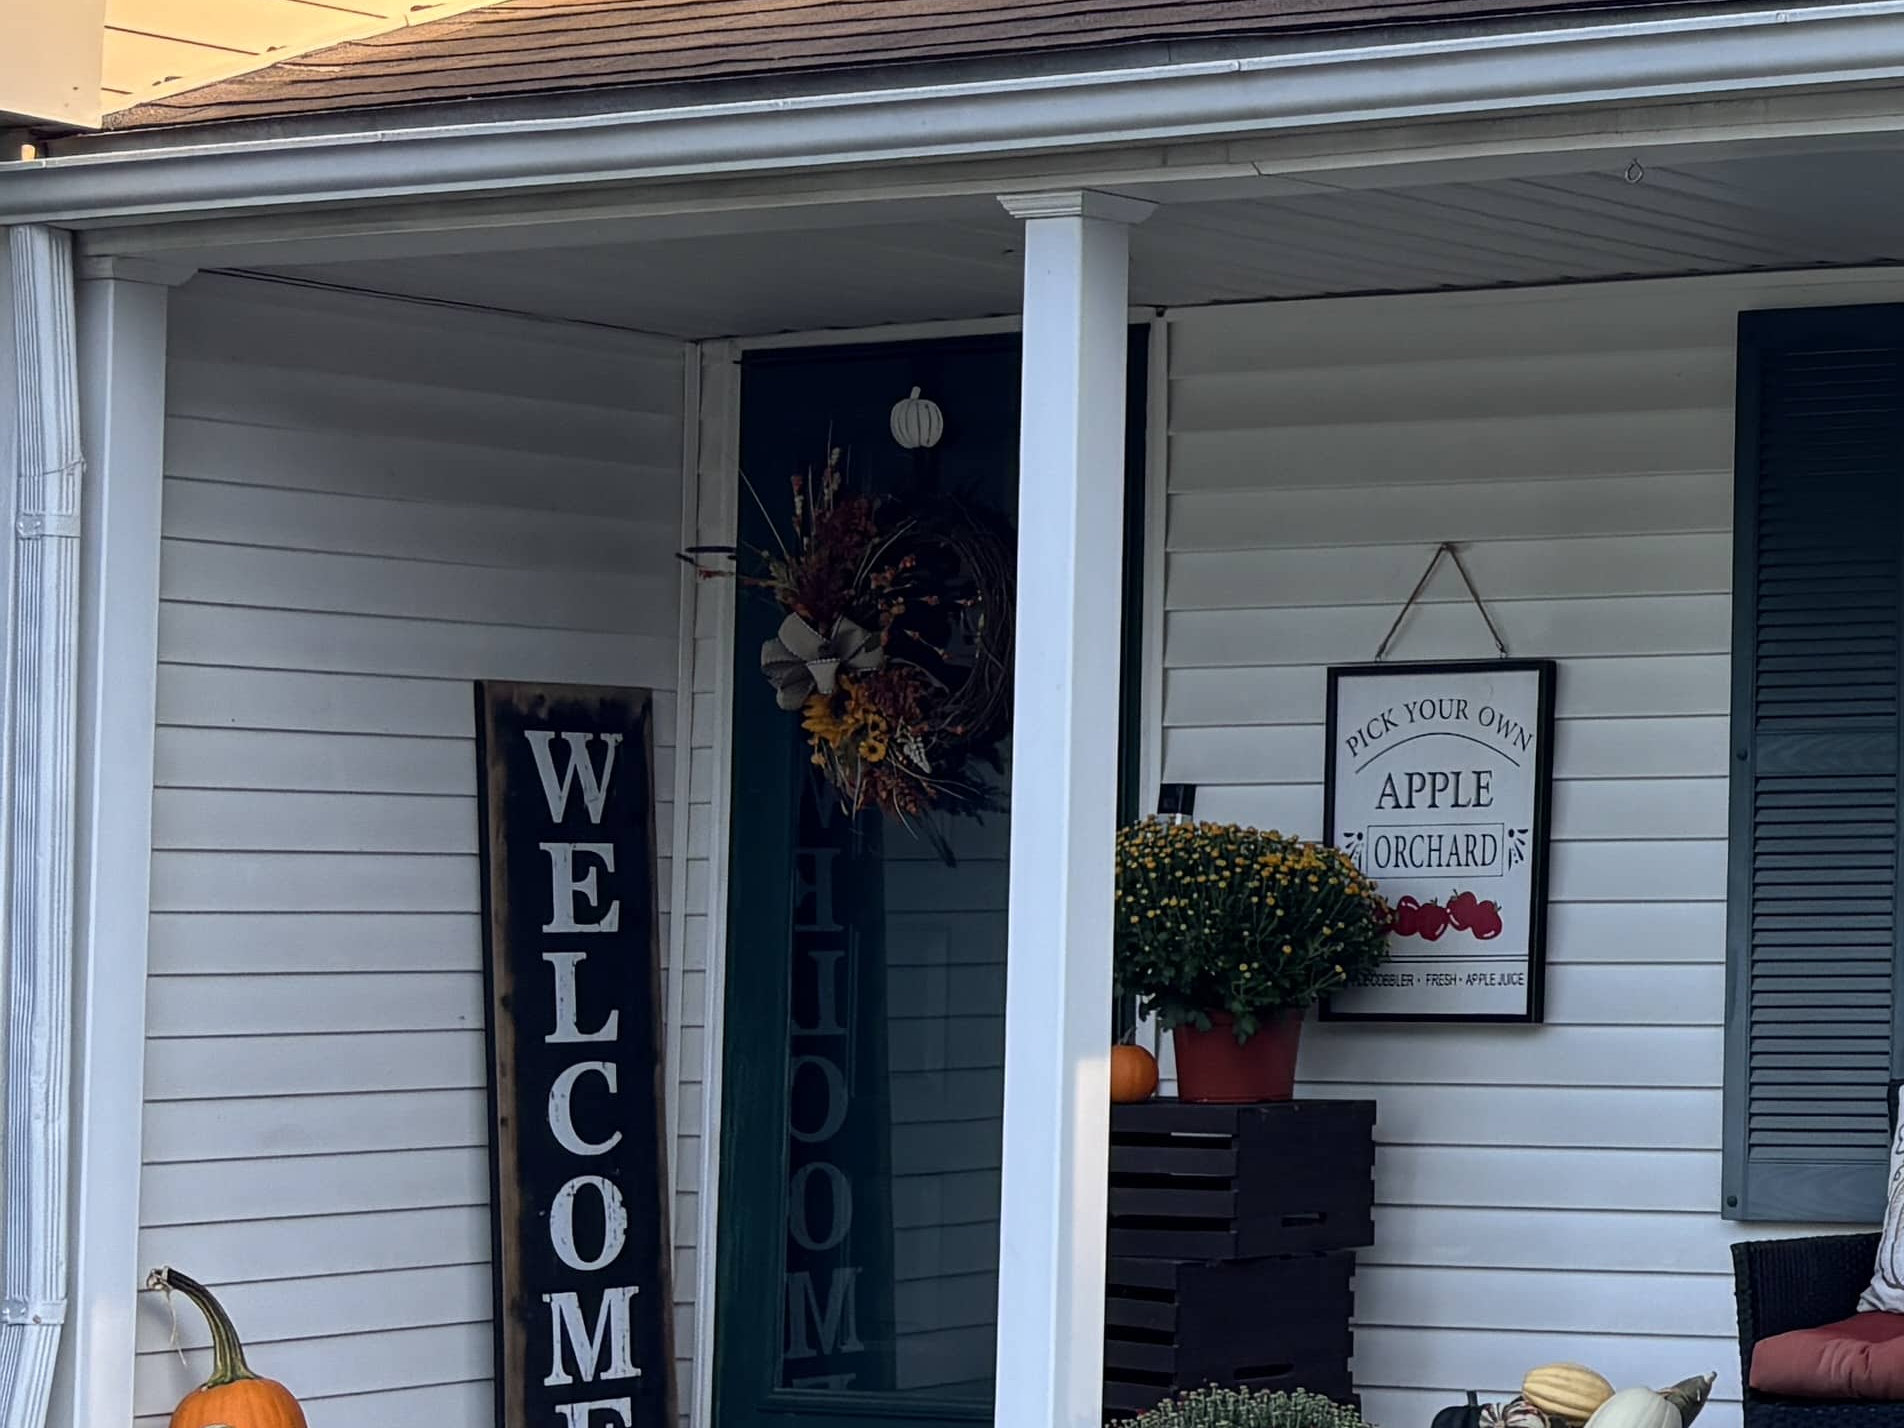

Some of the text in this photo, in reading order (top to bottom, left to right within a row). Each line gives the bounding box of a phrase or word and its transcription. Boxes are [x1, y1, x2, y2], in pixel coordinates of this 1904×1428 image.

[1345, 697, 1534, 758] PICK YOUR OWN
[1374, 769, 1495, 811] APPLE
[1374, 833, 1498, 870] ORCHARD
[1425, 973, 1456, 987] FRESH
[1465, 972, 1496, 987] APPLE
[1497, 972, 1525, 986] JUICE
